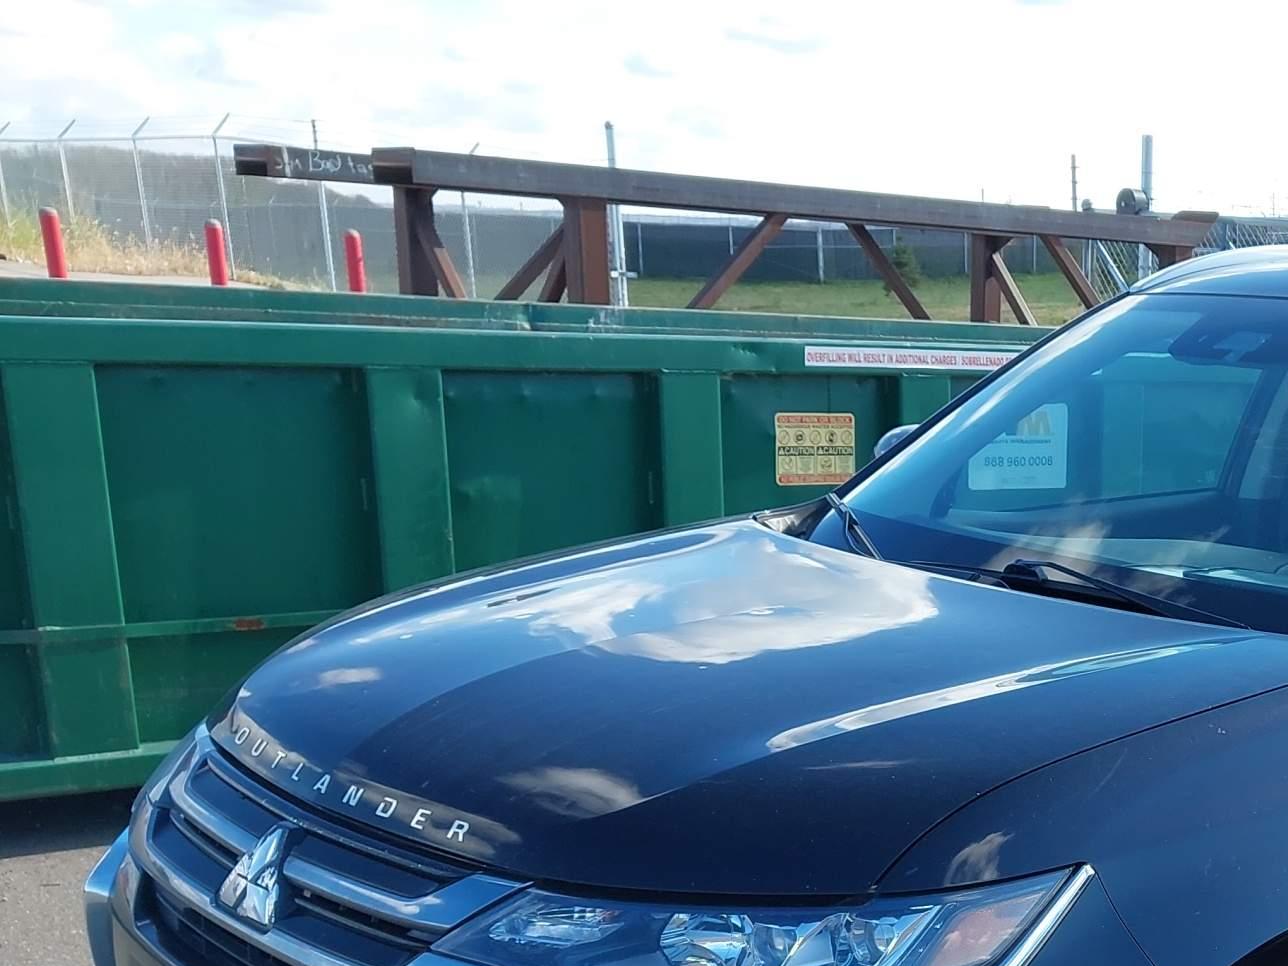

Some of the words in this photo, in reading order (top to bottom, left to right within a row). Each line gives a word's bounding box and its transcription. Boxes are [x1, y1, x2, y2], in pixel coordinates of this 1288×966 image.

[848, 353, 862, 363] WILL
[863, 353, 886, 364] RESULT
[785, 446, 815, 455] CAUTION
[823, 447, 853, 455] CAUTION
[234, 727, 470, 843] OUTLANDER
